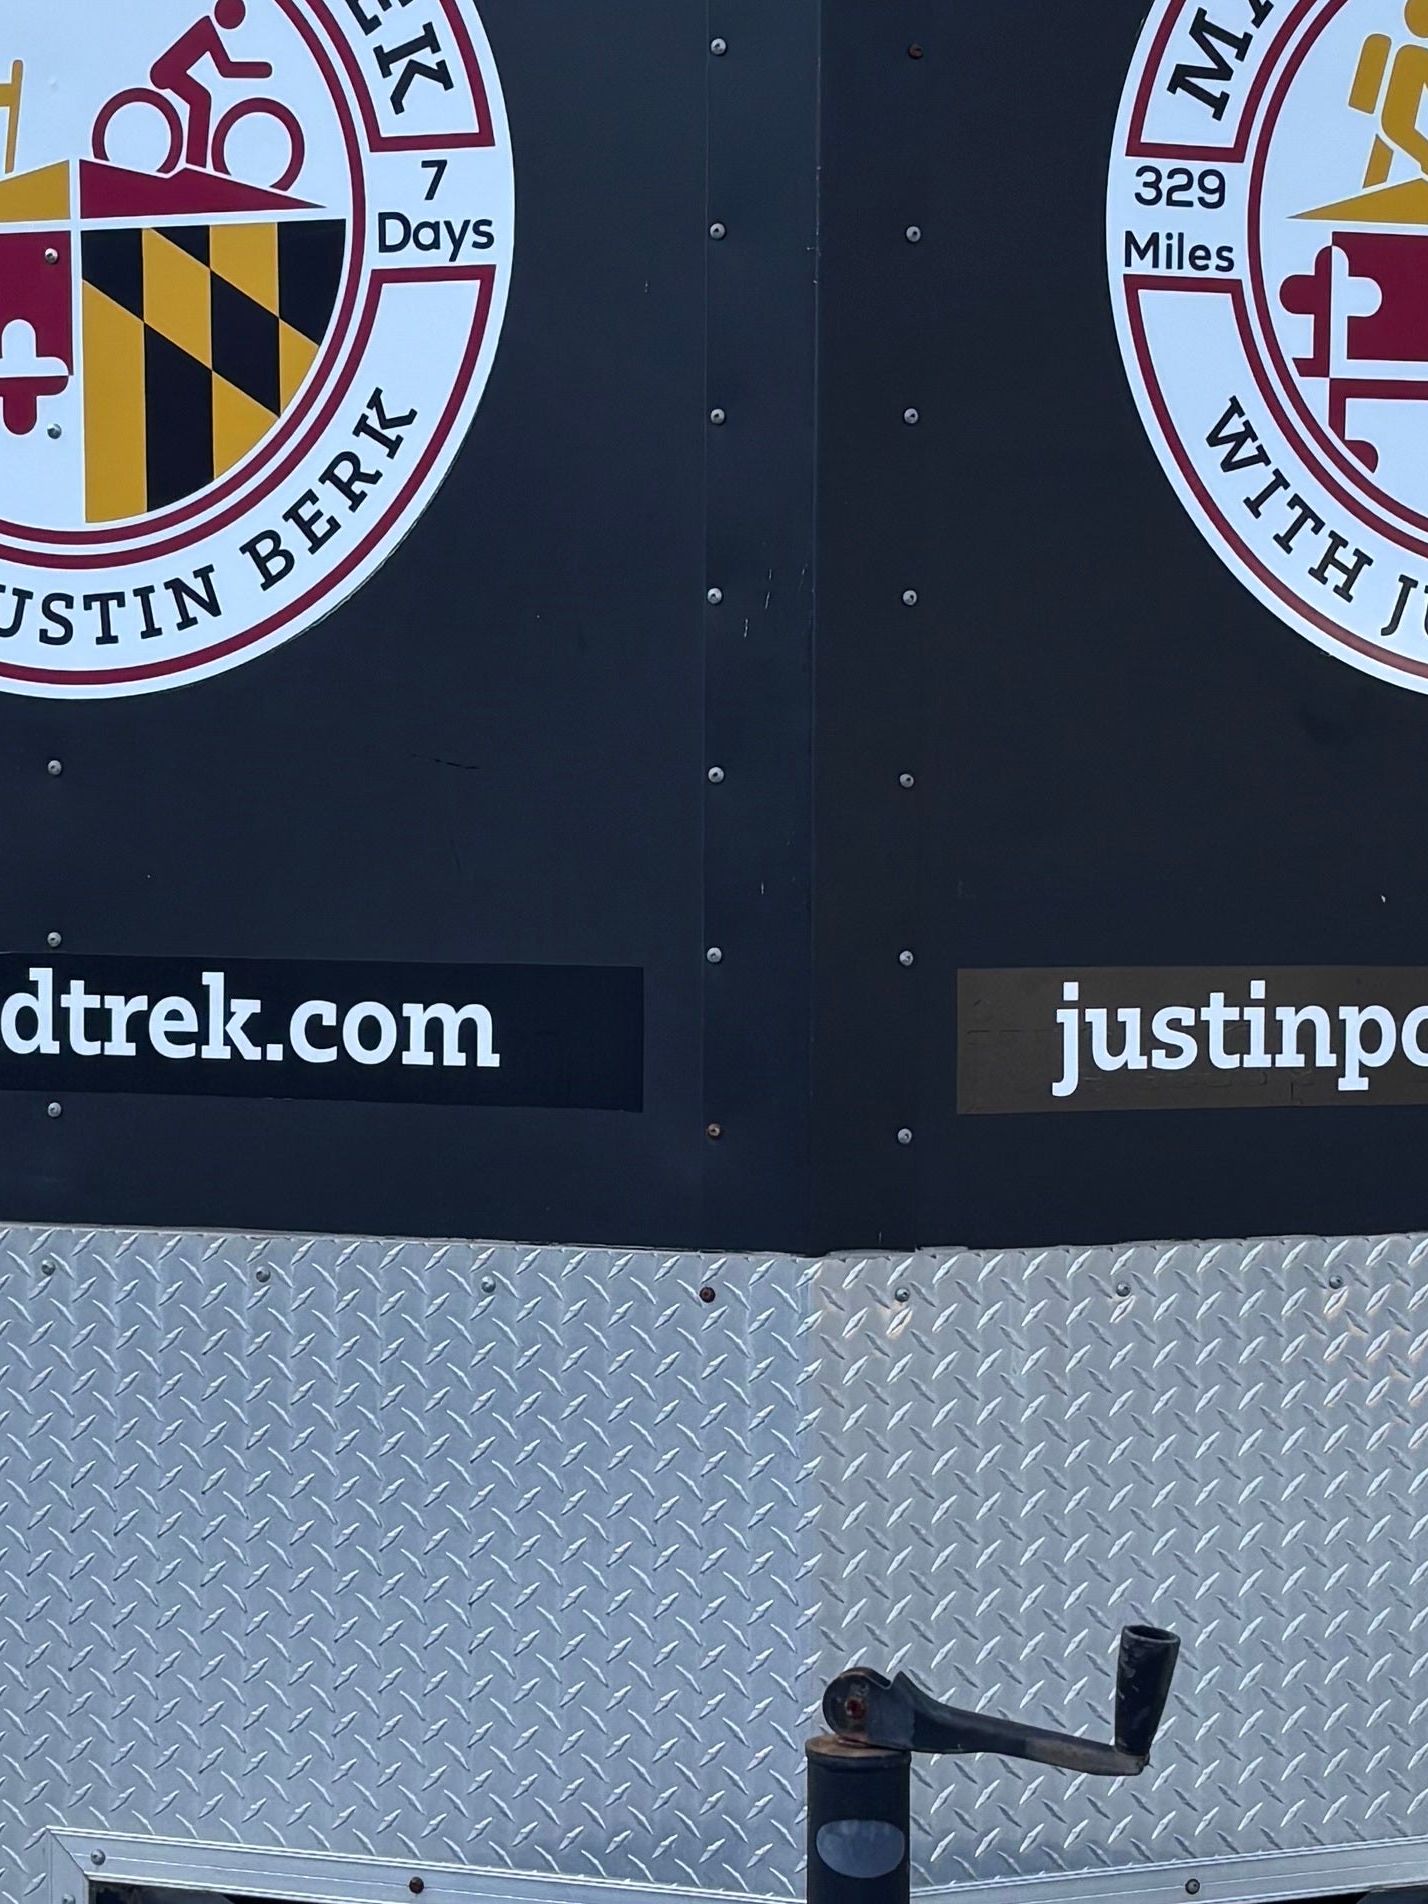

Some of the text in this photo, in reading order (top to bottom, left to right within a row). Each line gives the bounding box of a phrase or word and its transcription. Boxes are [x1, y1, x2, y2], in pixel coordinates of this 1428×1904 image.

[420, 159, 448, 201] 7
[1133, 165, 1227, 210] 329
[378, 210, 495, 263] Days
[1123, 230, 1236, 274] Miles
[239, 387, 419, 591] BERK
[1203, 395, 1375, 606] WITH
